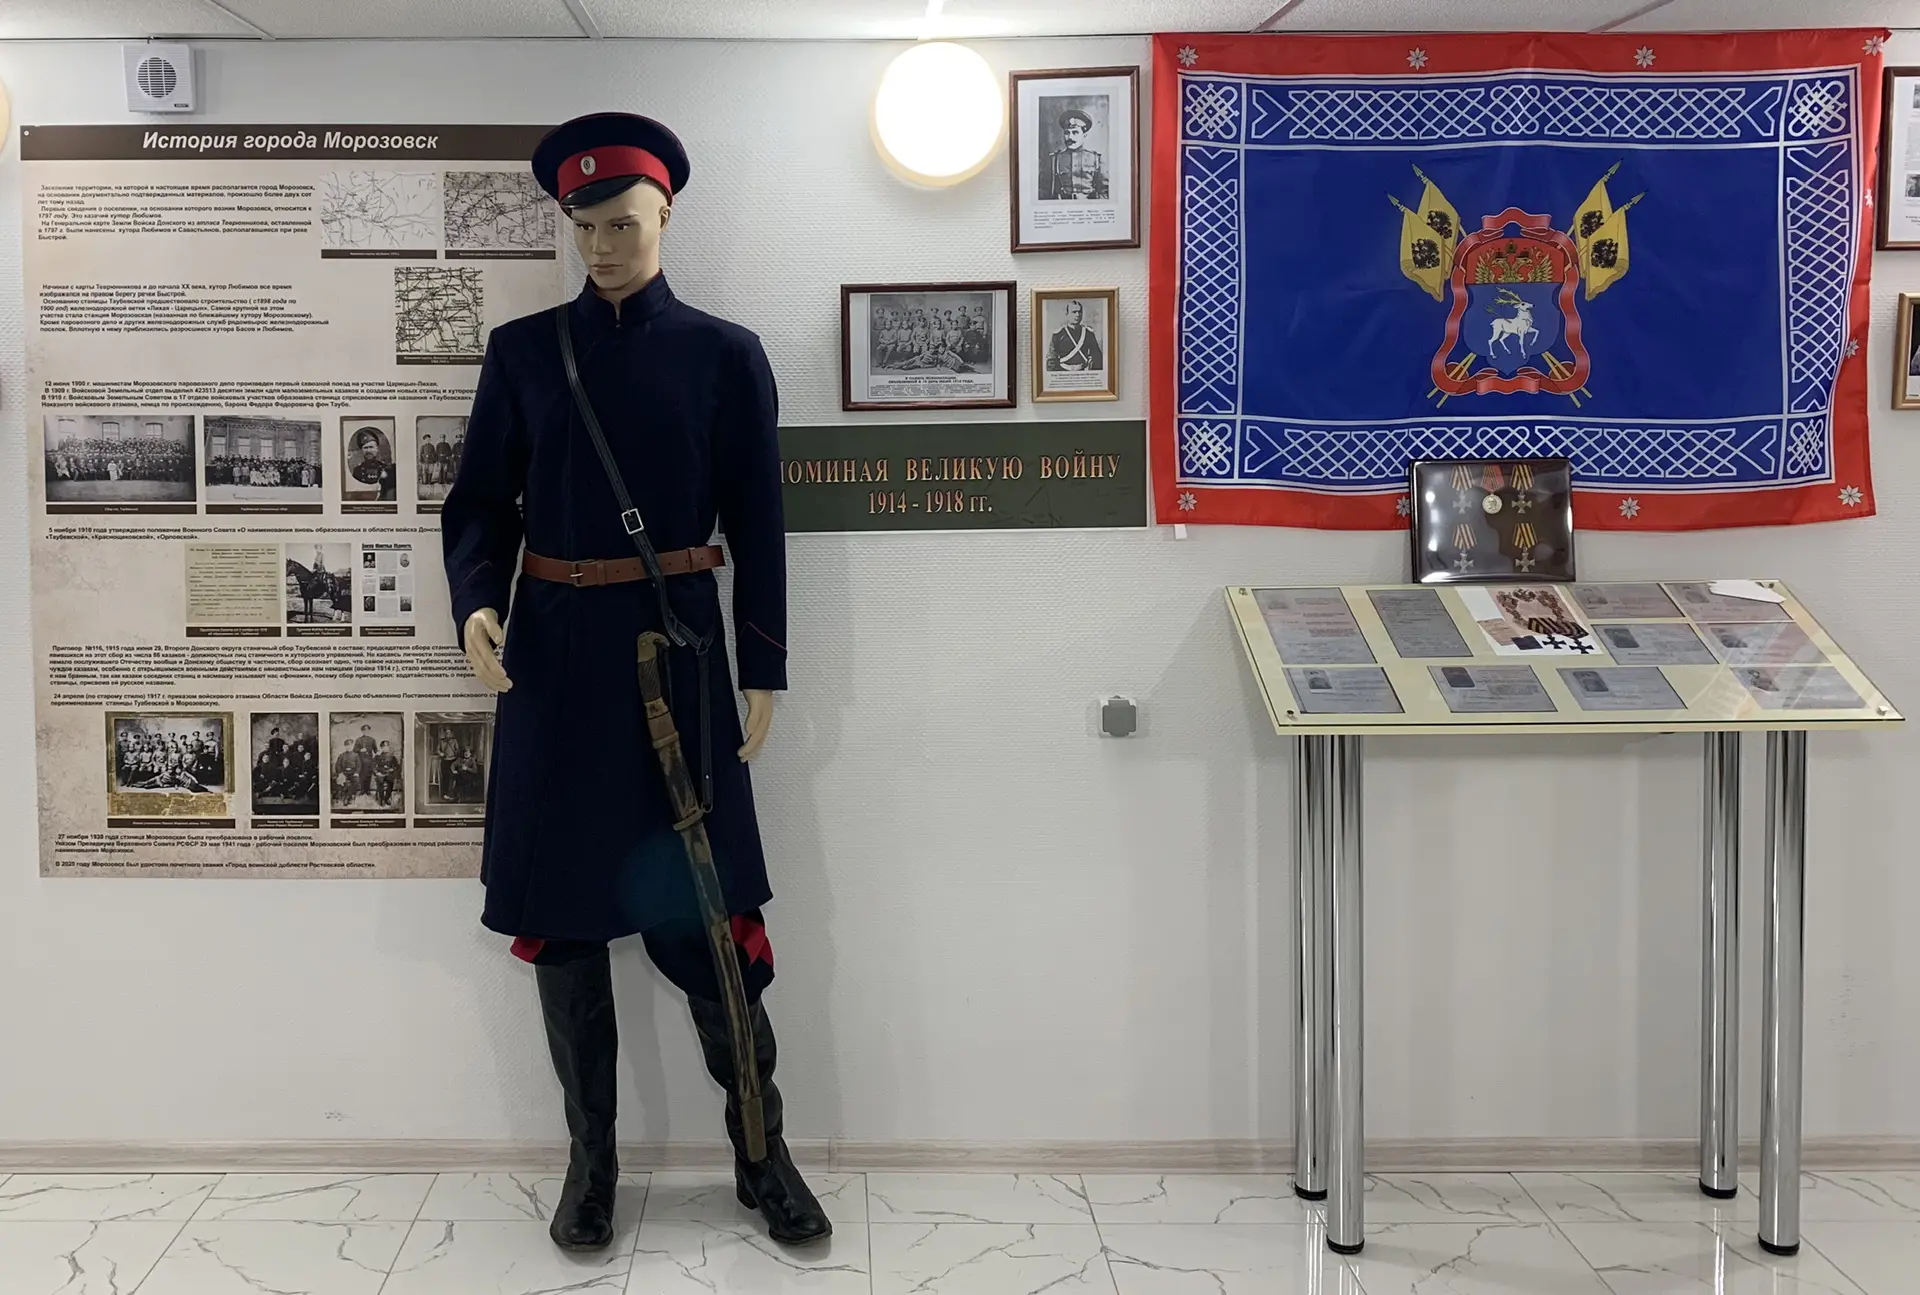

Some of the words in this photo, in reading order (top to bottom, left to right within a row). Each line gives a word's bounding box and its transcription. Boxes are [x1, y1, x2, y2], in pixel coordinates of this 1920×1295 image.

[142, 131, 237, 152] История
[243, 131, 317, 152] города
[323, 131, 438, 152] Морозовск
[906, 456, 1023, 481] ВЕЛИКУЮ
[1040, 449, 1120, 479] ВОЙНУ
[869, 491, 907, 514] 1914
[926, 490, 964, 513] 1918
[969, 496, 993, 512] гг.
